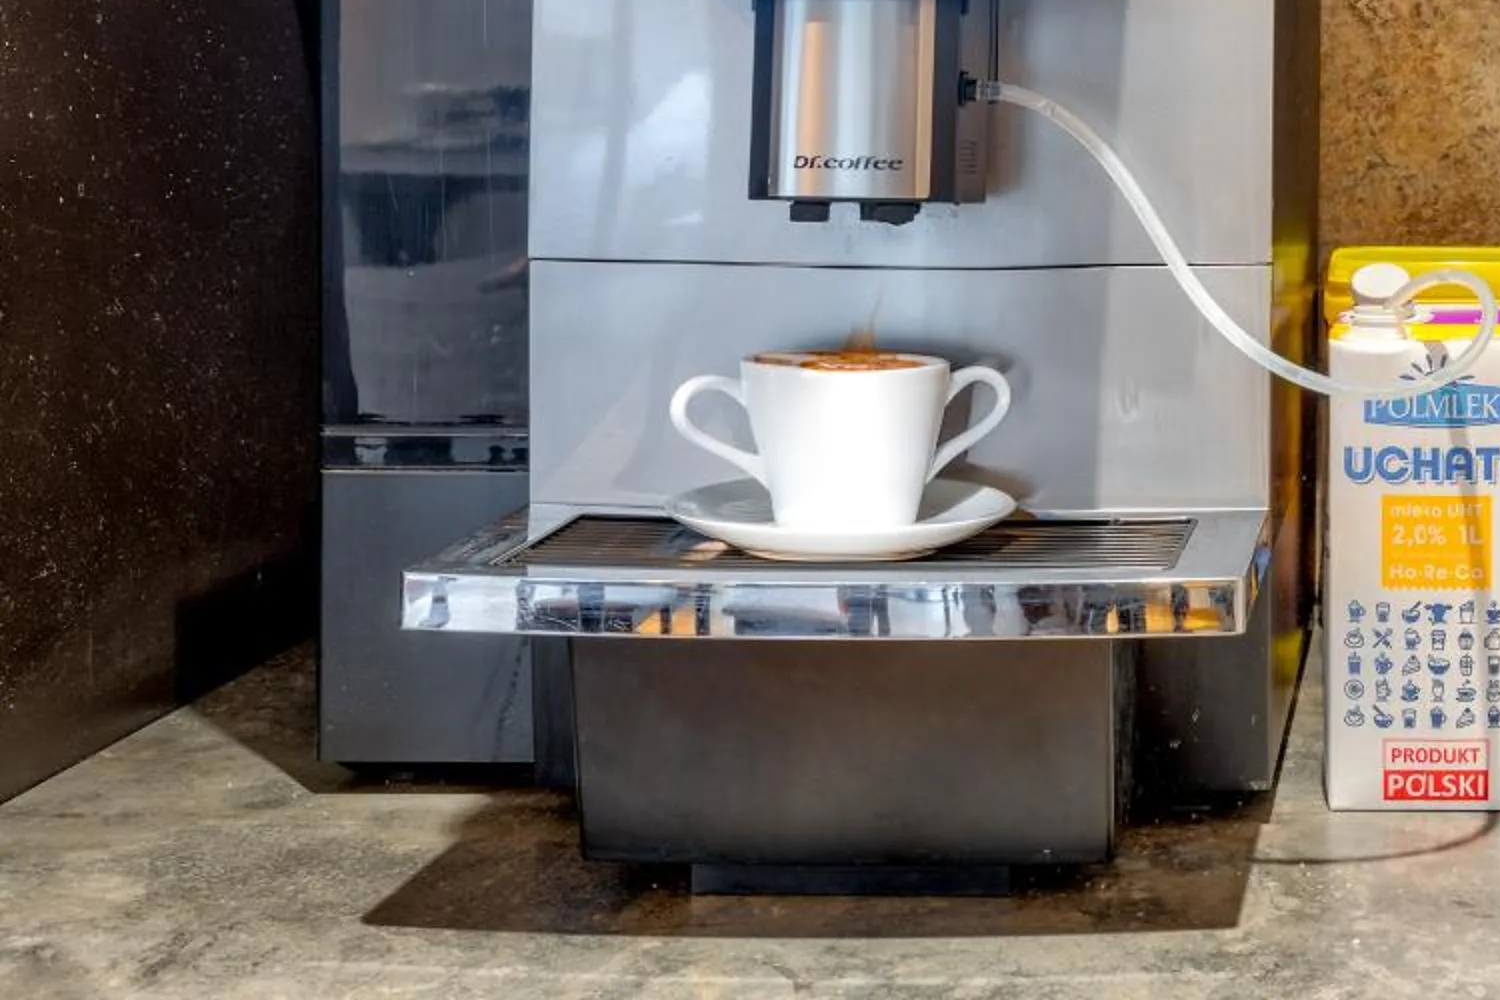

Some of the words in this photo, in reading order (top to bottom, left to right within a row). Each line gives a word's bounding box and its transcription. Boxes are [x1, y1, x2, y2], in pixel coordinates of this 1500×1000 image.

[794, 155, 903, 170] Dr.coffee
[1447, 502, 1483, 518] UHT
[1391, 523, 1447, 547] 2,0%
[1458, 524, 1485, 545] 1L
[1391, 747, 1481, 764] PRODUKT
[1387, 773, 1486, 797] POLSKI
